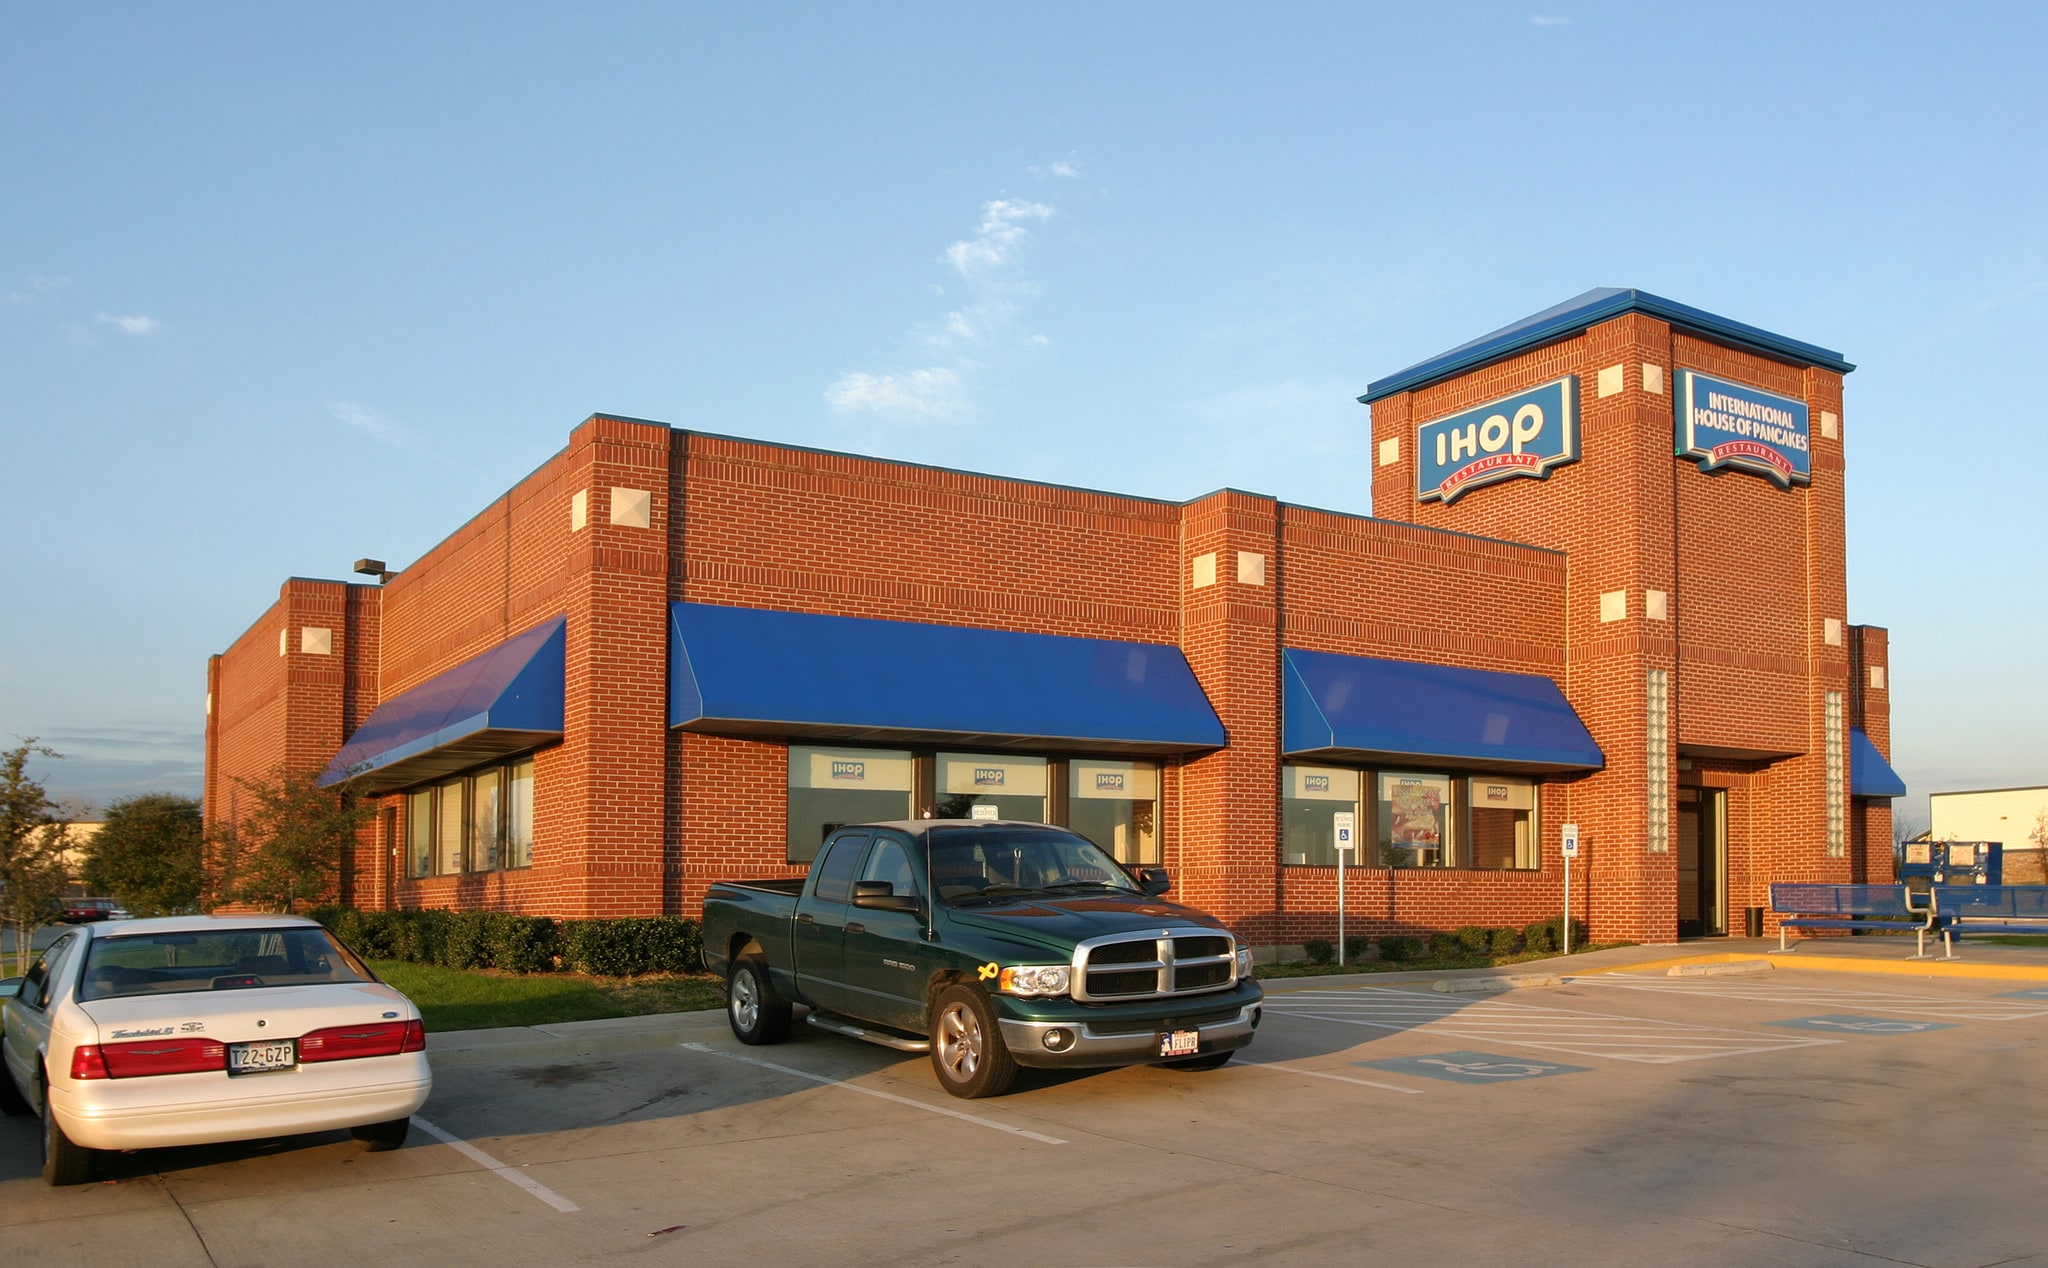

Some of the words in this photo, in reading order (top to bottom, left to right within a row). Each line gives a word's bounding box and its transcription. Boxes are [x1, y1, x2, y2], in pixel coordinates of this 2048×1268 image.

[1708, 391, 1795, 430] INTERNATIONAL
[1436, 403, 1544, 466] IHOP
[1694, 407, 1736, 433] HOUSE
[1736, 417, 1752, 437] OF
[1752, 422, 1808, 452] PANCAKES
[1717, 443, 1788, 469] RESTAURANT
[1445, 455, 1533, 488] RESTAURANT
[833, 763, 863, 776] IHOP
[976, 770, 1003, 782] IHOP
[1098, 775, 1123, 787] IHOP
[1306, 777, 1328, 788] IHOP
[1488, 787, 1507, 798] IHOP
